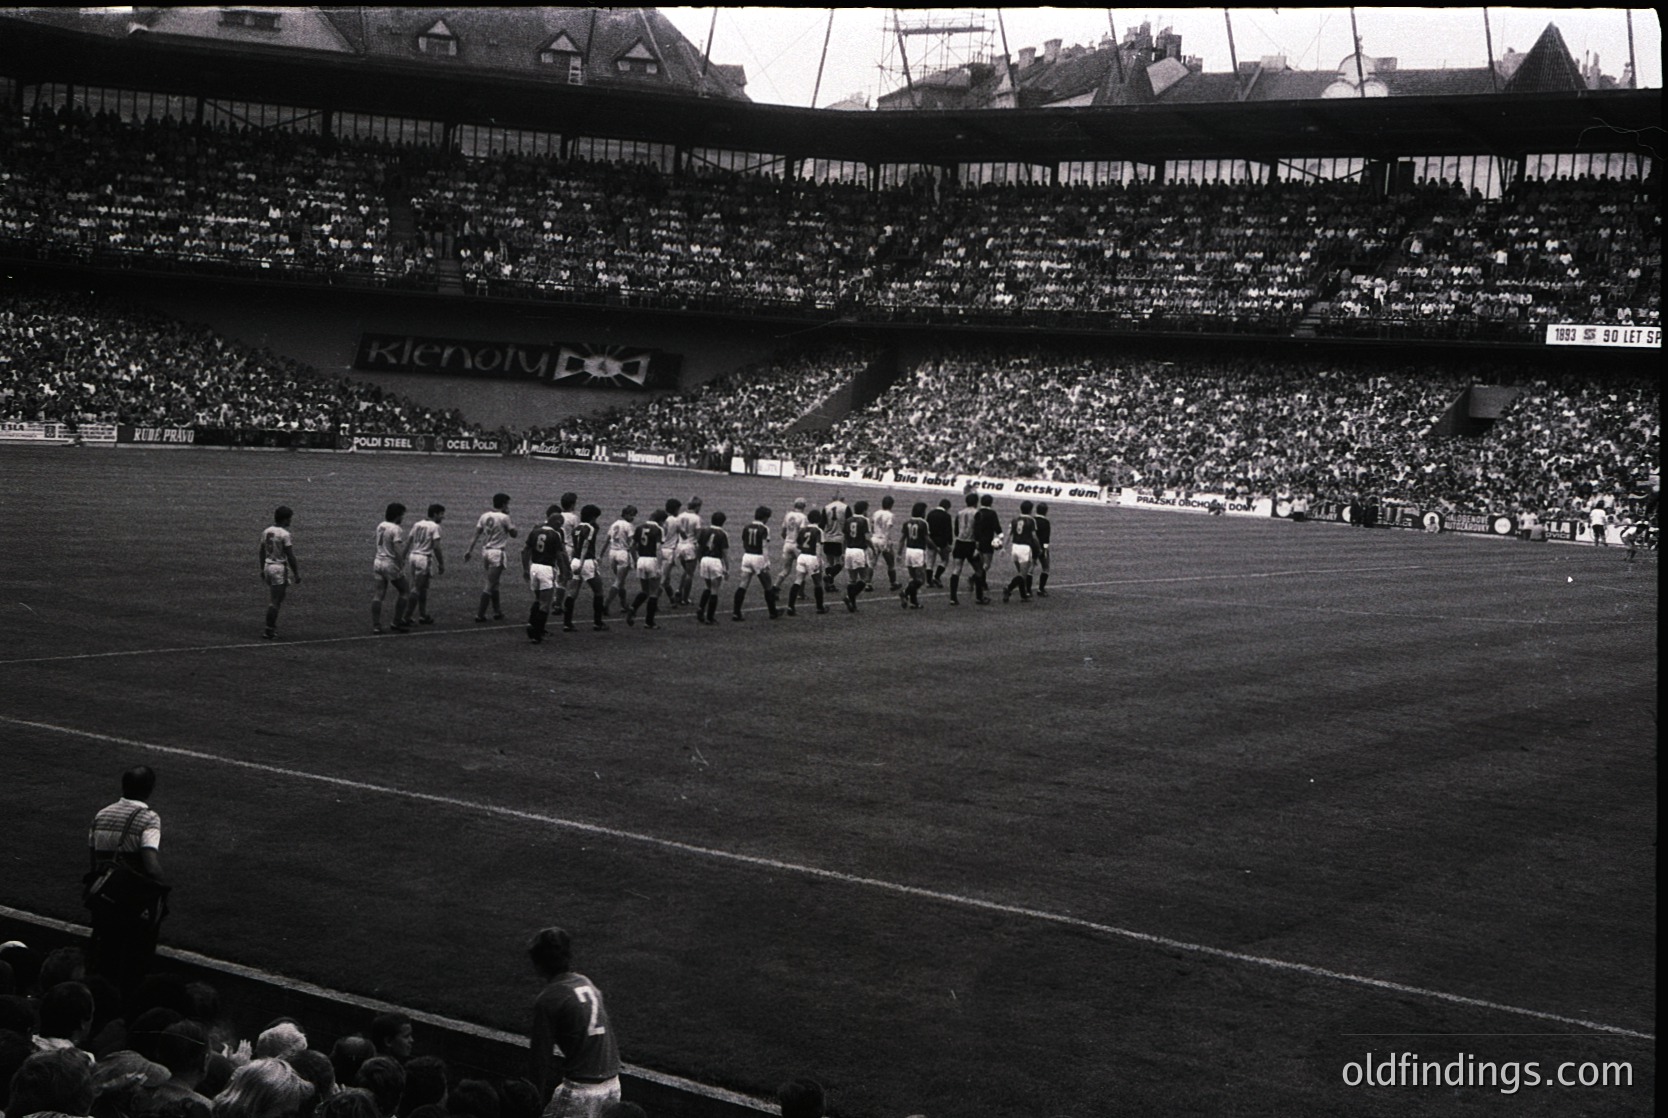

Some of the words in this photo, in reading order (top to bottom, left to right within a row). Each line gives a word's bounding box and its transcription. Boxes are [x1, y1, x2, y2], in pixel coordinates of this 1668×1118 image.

[1555, 328, 1576, 341] 1893
[1603, 329, 1618, 343] 90
[1623, 329, 1642, 344] LET
[353, 436, 381, 447] POLDI
[384, 438, 412, 448] STEEL
[447, 439, 470, 450] OCEL
[472, 439, 498, 450] POLDI
[627, 450, 665, 465] Havana
[830, 506, 838, 521] 1
[1228, 502, 1257, 513] DOMY
[850, 522, 858, 538] 9
[907, 523, 919, 540] 10
[1016, 520, 1025, 535] 8
[536, 533, 546, 552] 6
[641, 528, 650, 546] 5
[748, 528, 758, 546] 11
[802, 532, 812, 548] 2
[573, 985, 606, 1037] 2
